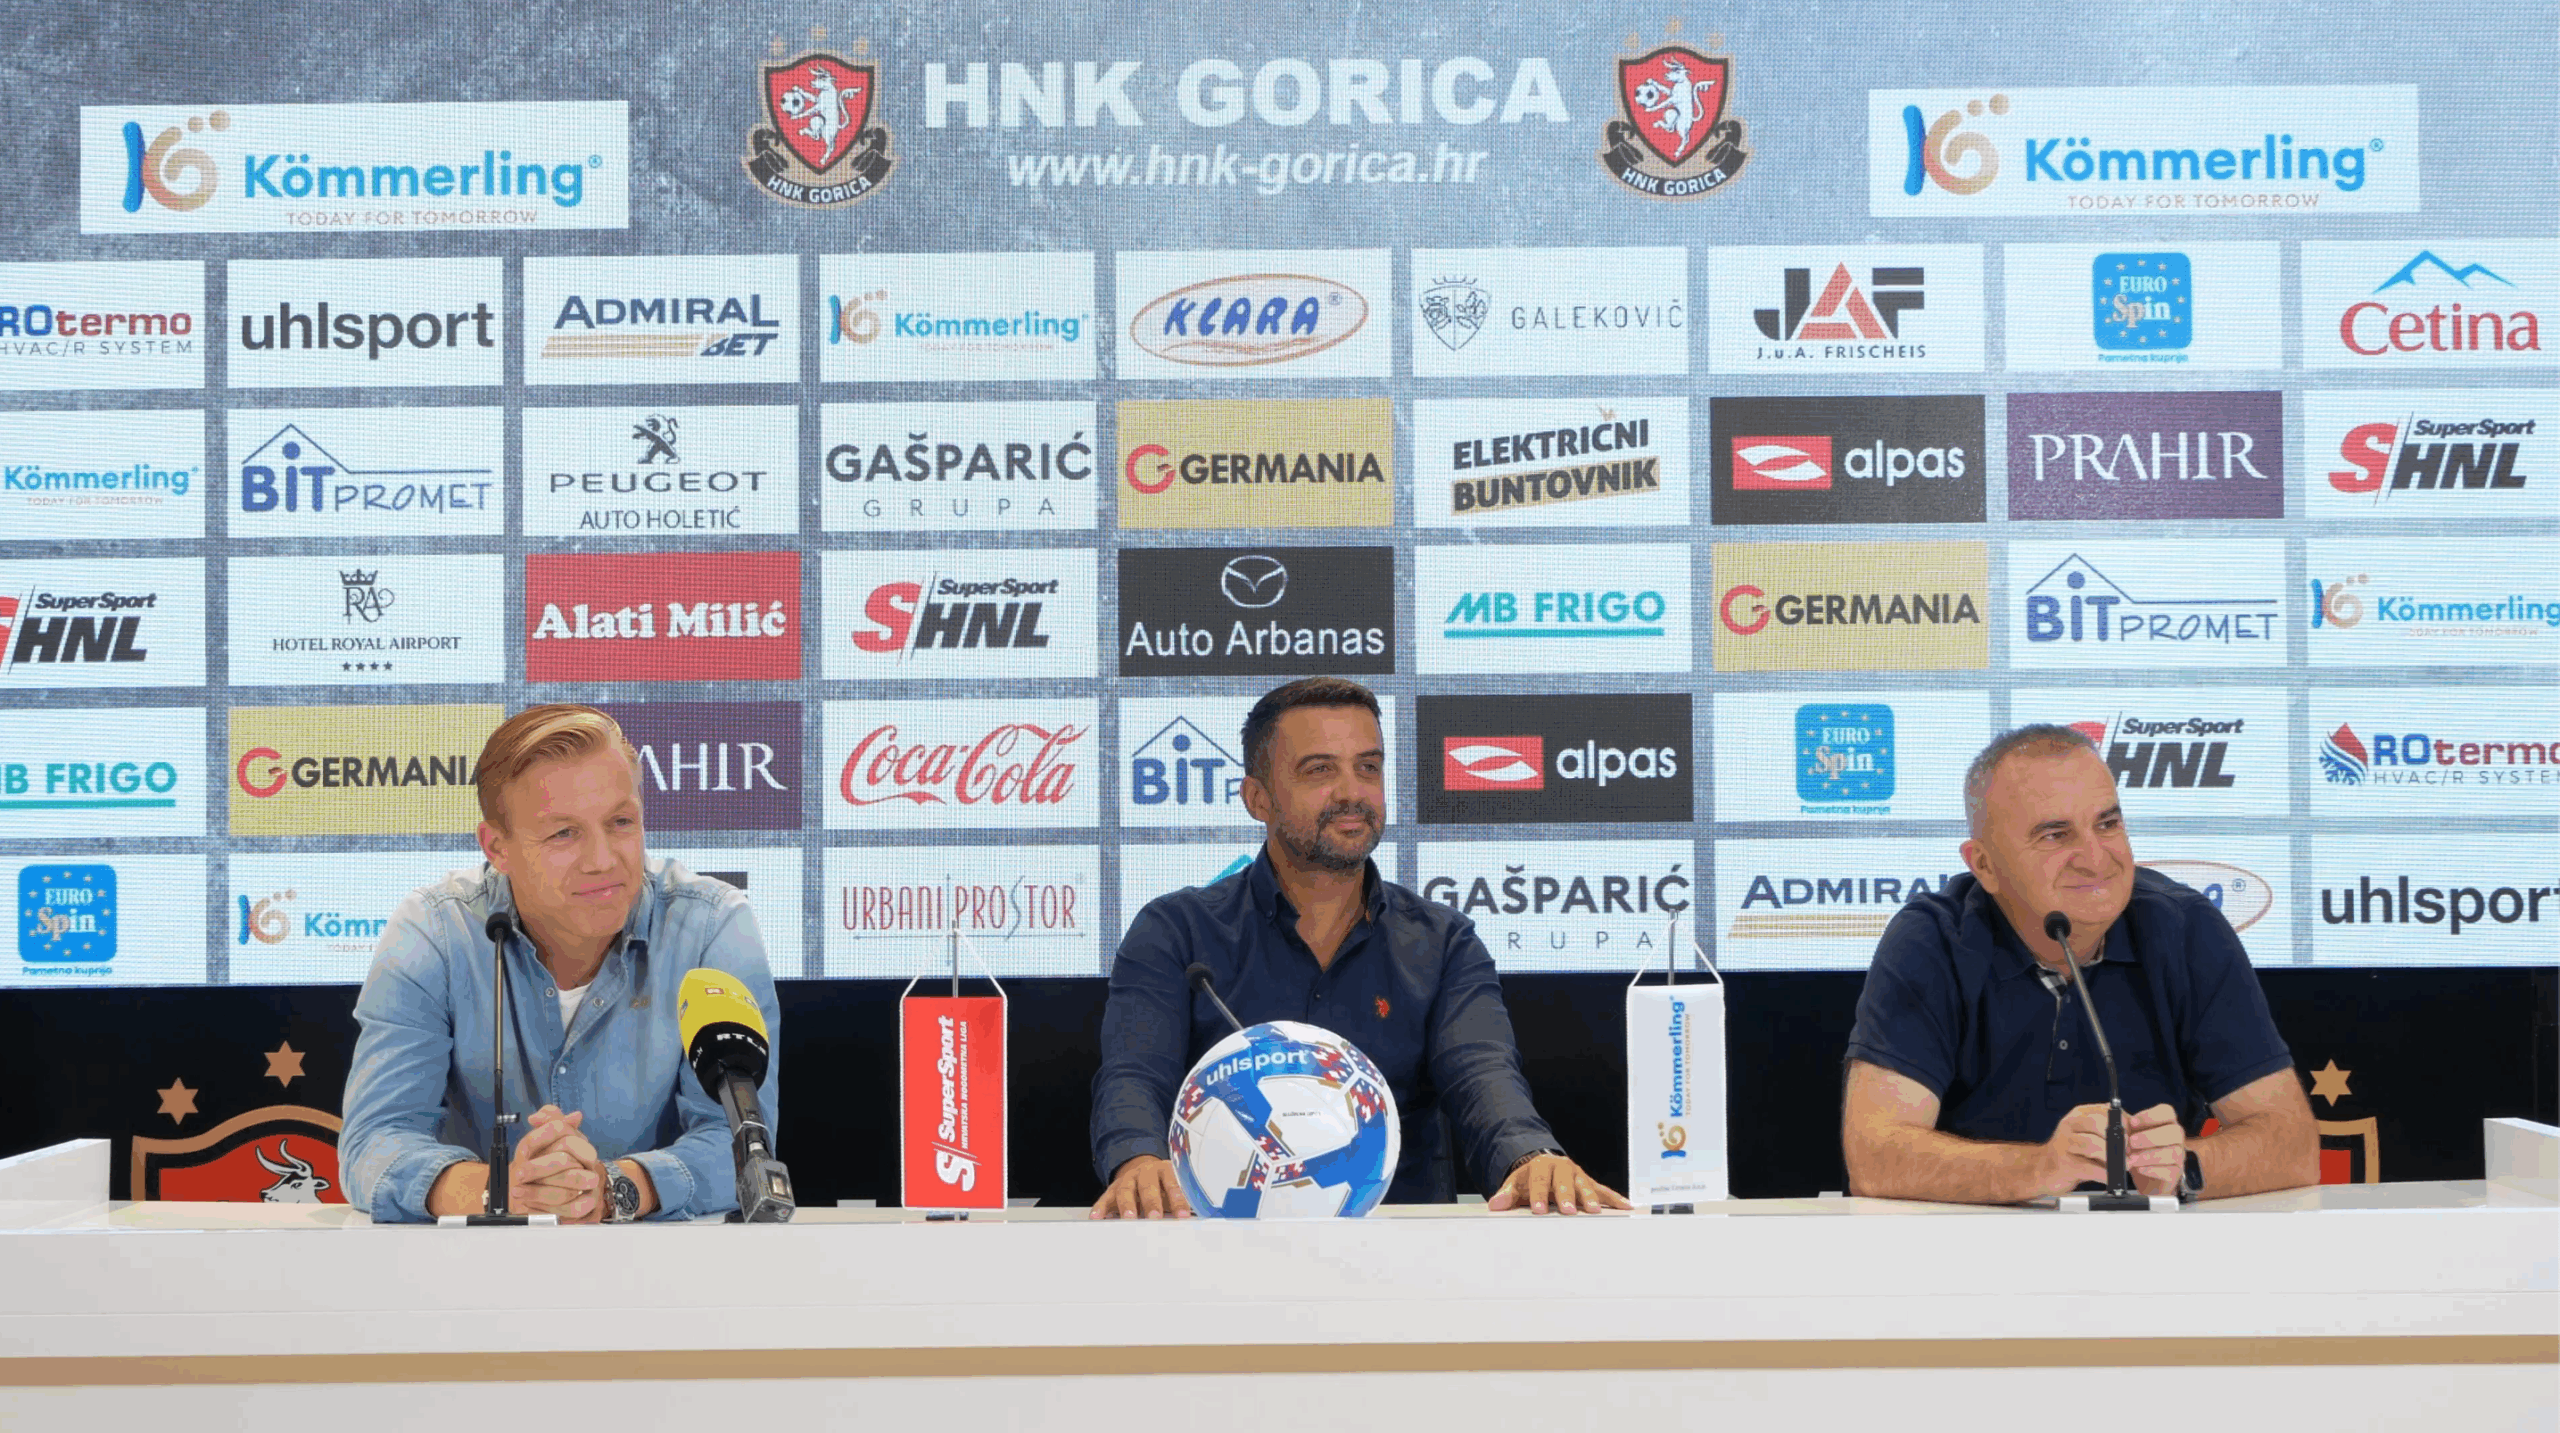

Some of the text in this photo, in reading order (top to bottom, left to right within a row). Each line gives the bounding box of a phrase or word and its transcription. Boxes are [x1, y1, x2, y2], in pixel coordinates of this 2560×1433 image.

[924, 56, 1570, 129] HNK GORICA
[1008, 143, 1488, 196] www.hnk-gorica.hr
[1621, 167, 1727, 195] HNK GORICA
[767, 175, 873, 203] HNK GORICA
[2068, 193, 2320, 210] TODAY FOR TOMORROW
[287, 209, 537, 226] TODAY FOR TOMORROW
[2120, 276, 2168, 293] EURO
[553, 294, 780, 328] ADMIRAL
[1163, 296, 1320, 336] KLARA
[2112, 293, 2171, 329] Spin
[241, 301, 495, 360] uhlsport
[701, 333, 778, 356] BET
[2339, 301, 2541, 356] Cetina
[100, 340, 192, 355] SYSTEM
[1825, 344, 1926, 359] FRISCHEIS
[2414, 418, 2536, 438] SuperSport
[825, 432, 1092, 483] GAŠPARIĆ
[1180, 453, 1384, 484] GERMANIA
[1844, 440, 1966, 487] alpas
[2031, 432, 2268, 481] PRAHIR
[551, 472, 767, 492] PEUGEOT
[1454, 457, 1657, 511] BUNTOVNIK
[580, 504, 741, 530] AUTO HOLETIĆ
[863, 498, 1055, 517] GRUPA
[36, 592, 156, 612] SuperSport
[936, 578, 1059, 597] SuperSport
[533, 600, 786, 640] Alati Milić
[1444, 590, 1665, 625] MB FRIGO
[1775, 593, 1980, 625] GERMANIA
[272, 636, 462, 651] HOTEL ROYAL AIRPORT
[1126, 620, 1385, 656] Auto Arbanas
[1822, 727, 1870, 744] EURO
[2122, 718, 2244, 737] SuperSport
[46, 761, 177, 793] FRIGO
[839, 723, 1091, 807] Coca-Cola
[1556, 740, 1677, 786] alpas
[1815, 746, 1874, 780] Spin
[2374, 770, 2560, 785] HVAC/R SYSTE
[45, 888, 93, 906] EURO
[1423, 864, 1690, 915] GAŠPARIĆ
[2321, 875, 2560, 935] uhlspor
[843, 885, 942, 931] URBANI
[36, 907, 97, 942] Spin
[1508, 931, 1654, 949] RUPA
[959, 1020, 968, 1043] LIGA
[937, 1015, 958, 1143] SuperSport
[1206, 1050, 1308, 1086] uhlsport
[1684, 1067, 1692, 1082] FOR
[1684, 1086, 1692, 1117] TODAY
